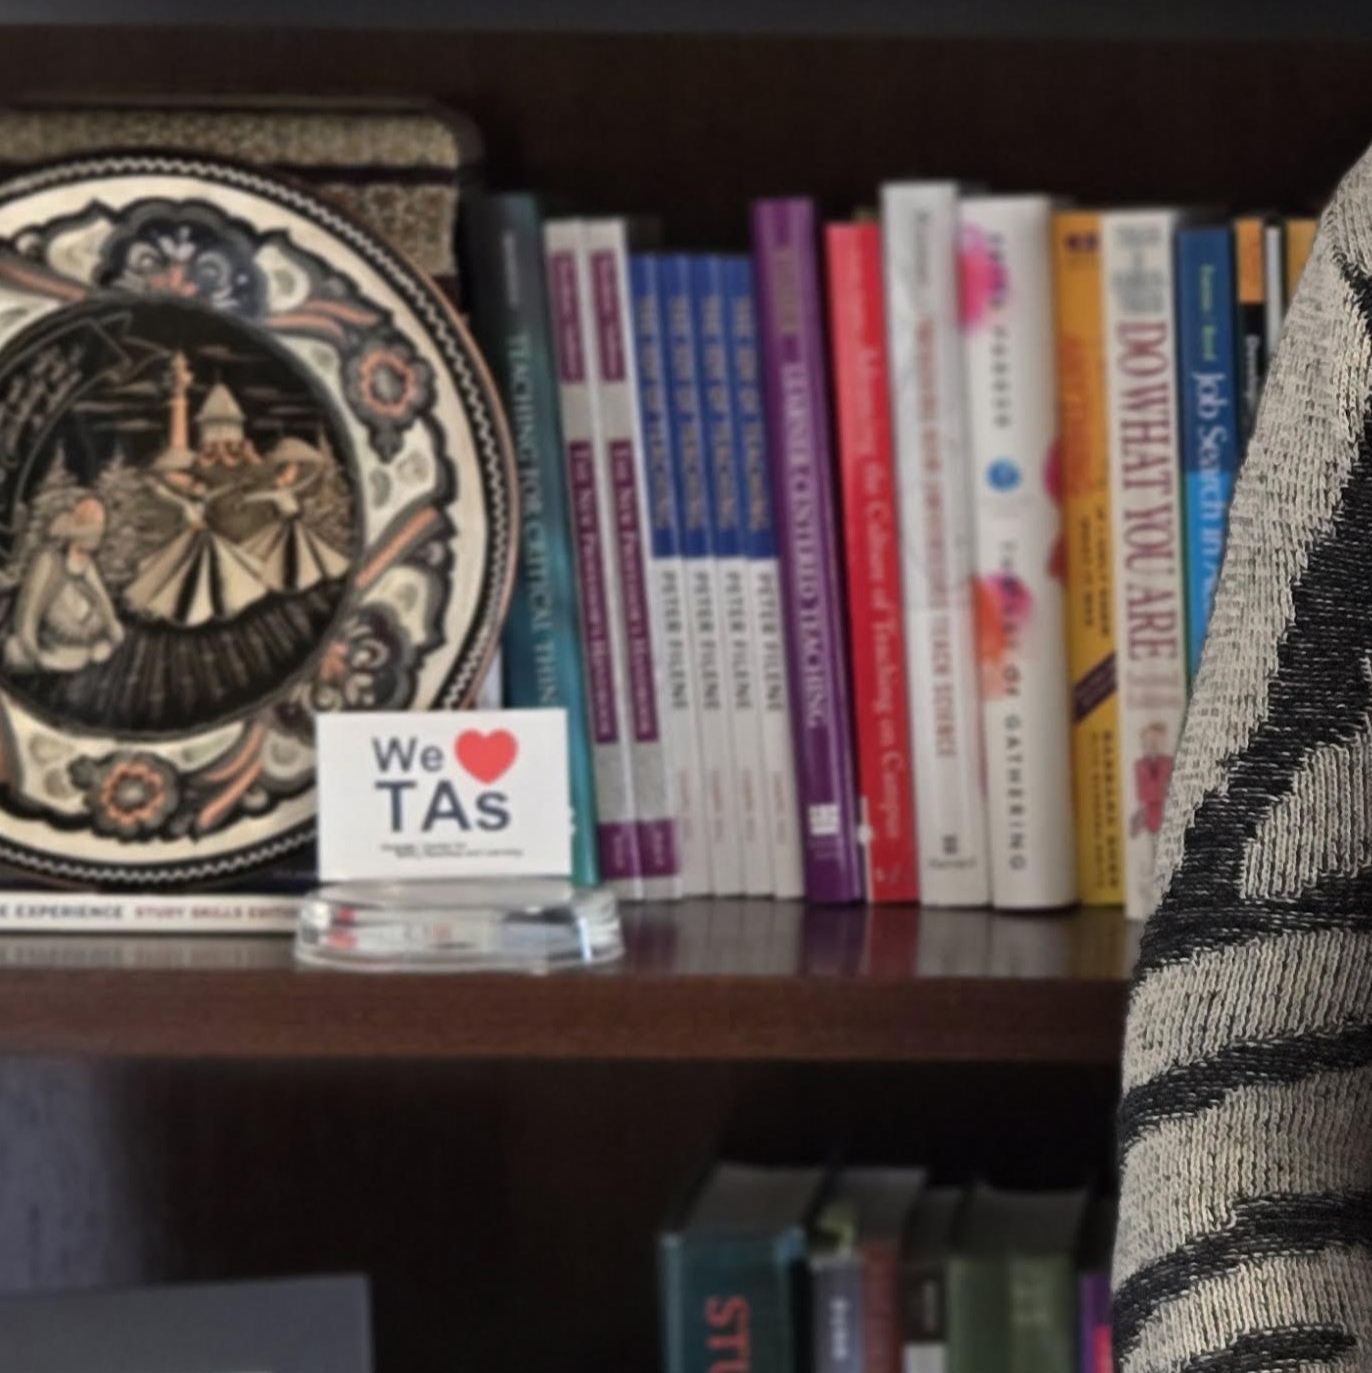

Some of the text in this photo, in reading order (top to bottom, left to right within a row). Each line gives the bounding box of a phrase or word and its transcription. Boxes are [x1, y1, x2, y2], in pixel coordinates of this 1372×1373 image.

[1117, 321, 1168, 378] DO
[1241, 334, 1260, 408] Develop
[507, 332, 539, 460] TEACHING
[1118, 381, 1172, 496] WHAT
[1191, 369, 1228, 421] Job
[1198, 424, 1228, 521] Search
[1123, 502, 1176, 580] YOU
[1200, 526, 1225, 556] in
[661, 571, 690, 713] PETER FILENE
[693, 571, 722, 713] PETER FILENE
[725, 571, 754, 713] PETER FILENE
[756, 571, 786, 713] PETER FILENE
[873, 616, 899, 715] Teaching
[1127, 582, 1178, 661] ARE
[800, 609, 825, 728] TEACHING
[372, 735, 445, 774] We
[933, 682, 958, 759] SCIENCE
[374, 779, 512, 834] TAs
[1003, 713, 1027, 872] GATHERING
[15, 904, 243, 919] EXPERIENCE STUDY SKILLS
